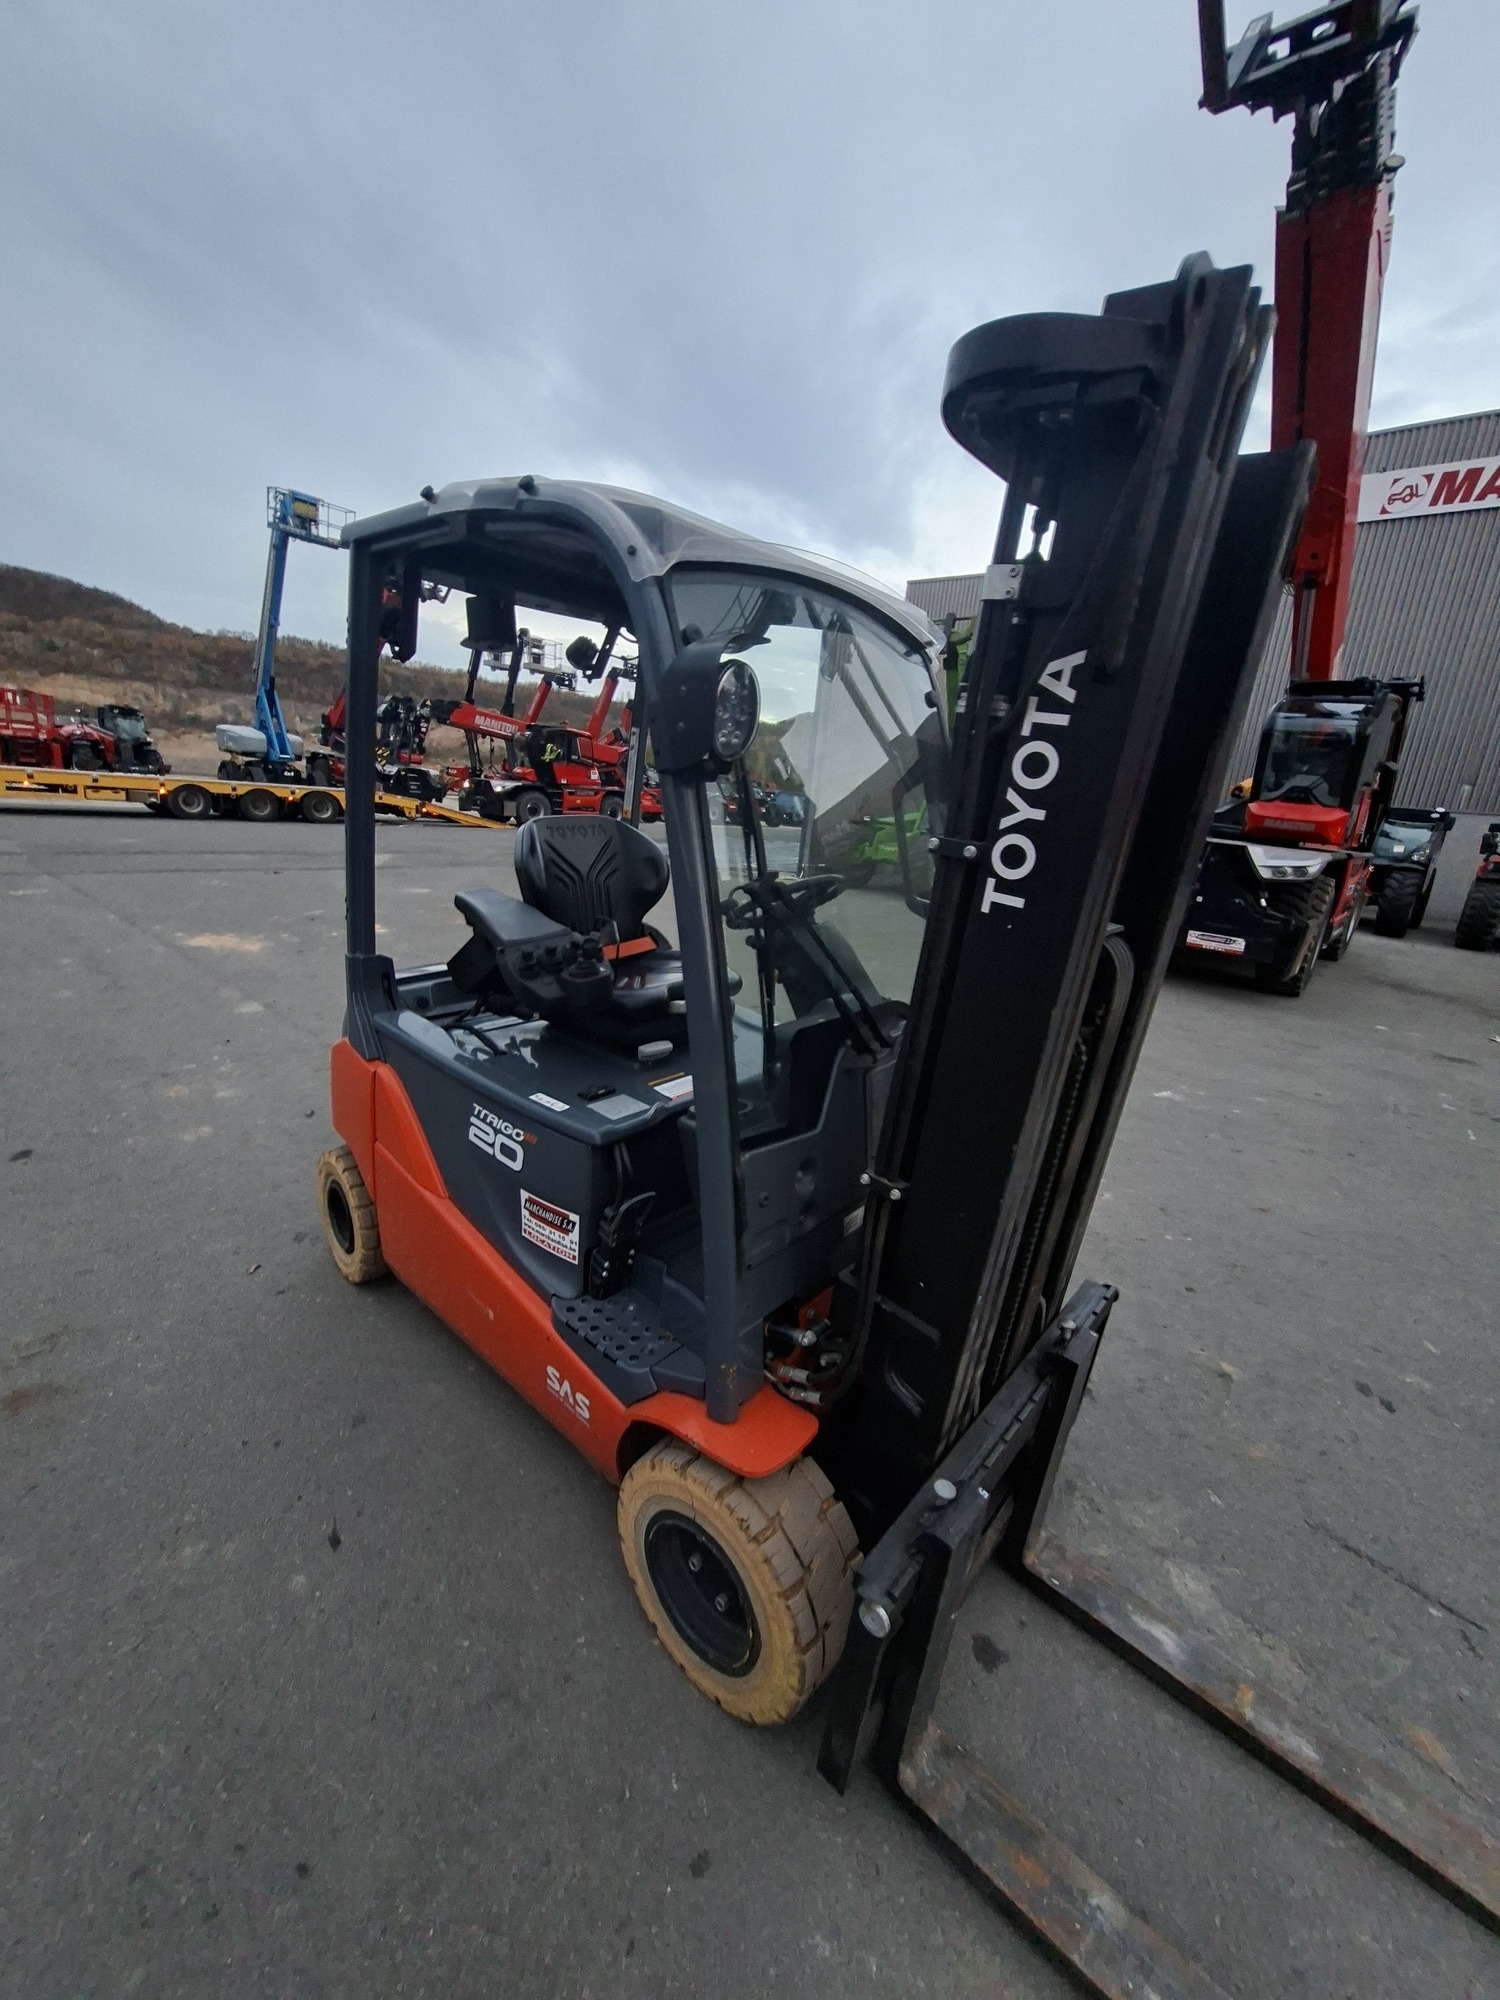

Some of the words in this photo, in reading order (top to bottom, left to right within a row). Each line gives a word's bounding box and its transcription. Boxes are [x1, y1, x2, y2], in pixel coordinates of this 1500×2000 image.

[474, 715, 519, 734] MANITOU
[981, 649, 1088, 914] TOYOTA
[546, 824, 607, 839] TOYOTA
[473, 1102, 525, 1141] TRAIGO
[469, 1116, 524, 1171] 20
[525, 1200, 562, 1226] MARCHANDISE
[525, 1229, 573, 1259] LOCATION
[546, 1365, 590, 1420] SAS
